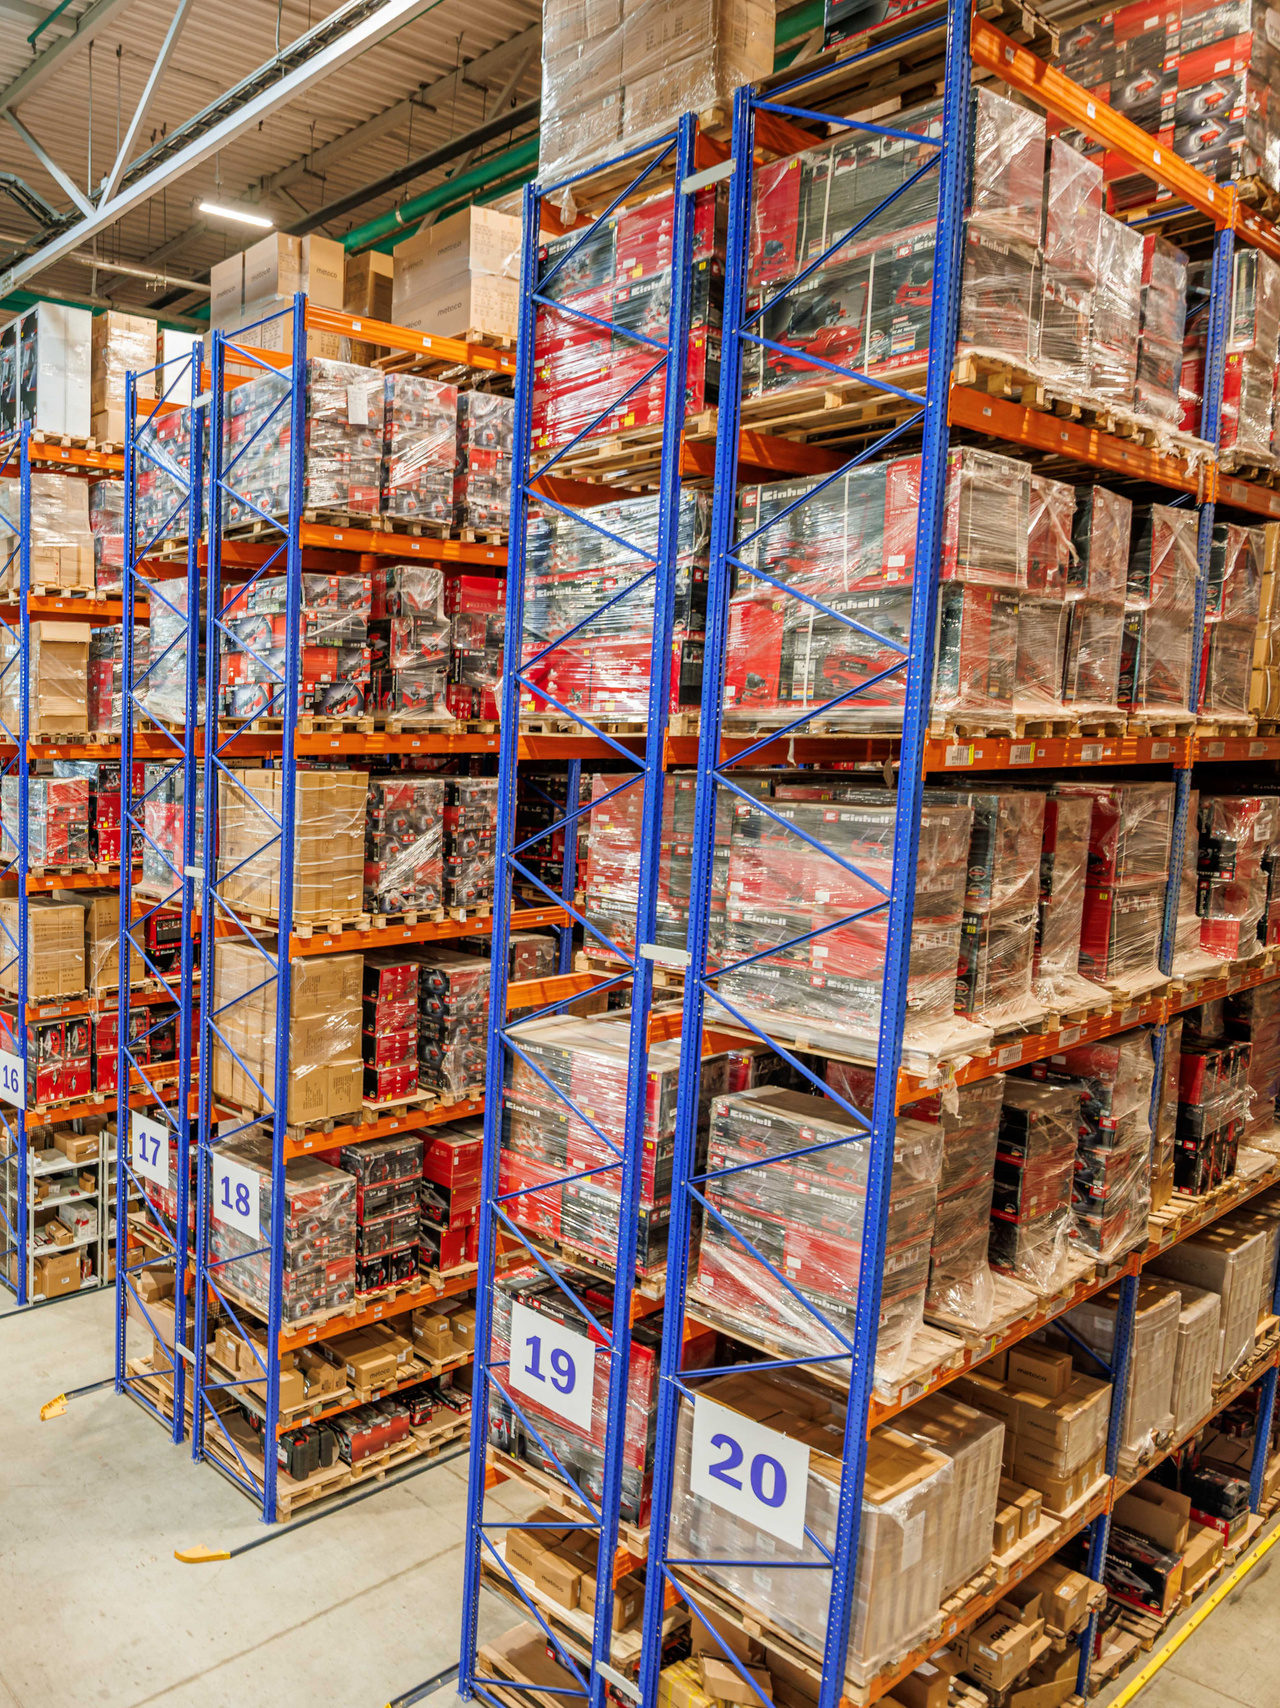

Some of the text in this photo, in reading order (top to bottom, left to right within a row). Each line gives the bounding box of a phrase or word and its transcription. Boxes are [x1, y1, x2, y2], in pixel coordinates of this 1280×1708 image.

[840, 813, 890, 824] Einhell
[743, 913, 787, 926] Einhell
[3, 1065, 19, 1093] 16
[506, 1100, 541, 1118] Einhell
[730, 1109, 772, 1127] Einhell
[139, 1132, 161, 1167] 17
[221, 1176, 250, 1216] 18
[721, 1209, 762, 1230] Einhell
[524, 1335, 576, 1394] 19
[708, 1433, 788, 1508] 20
